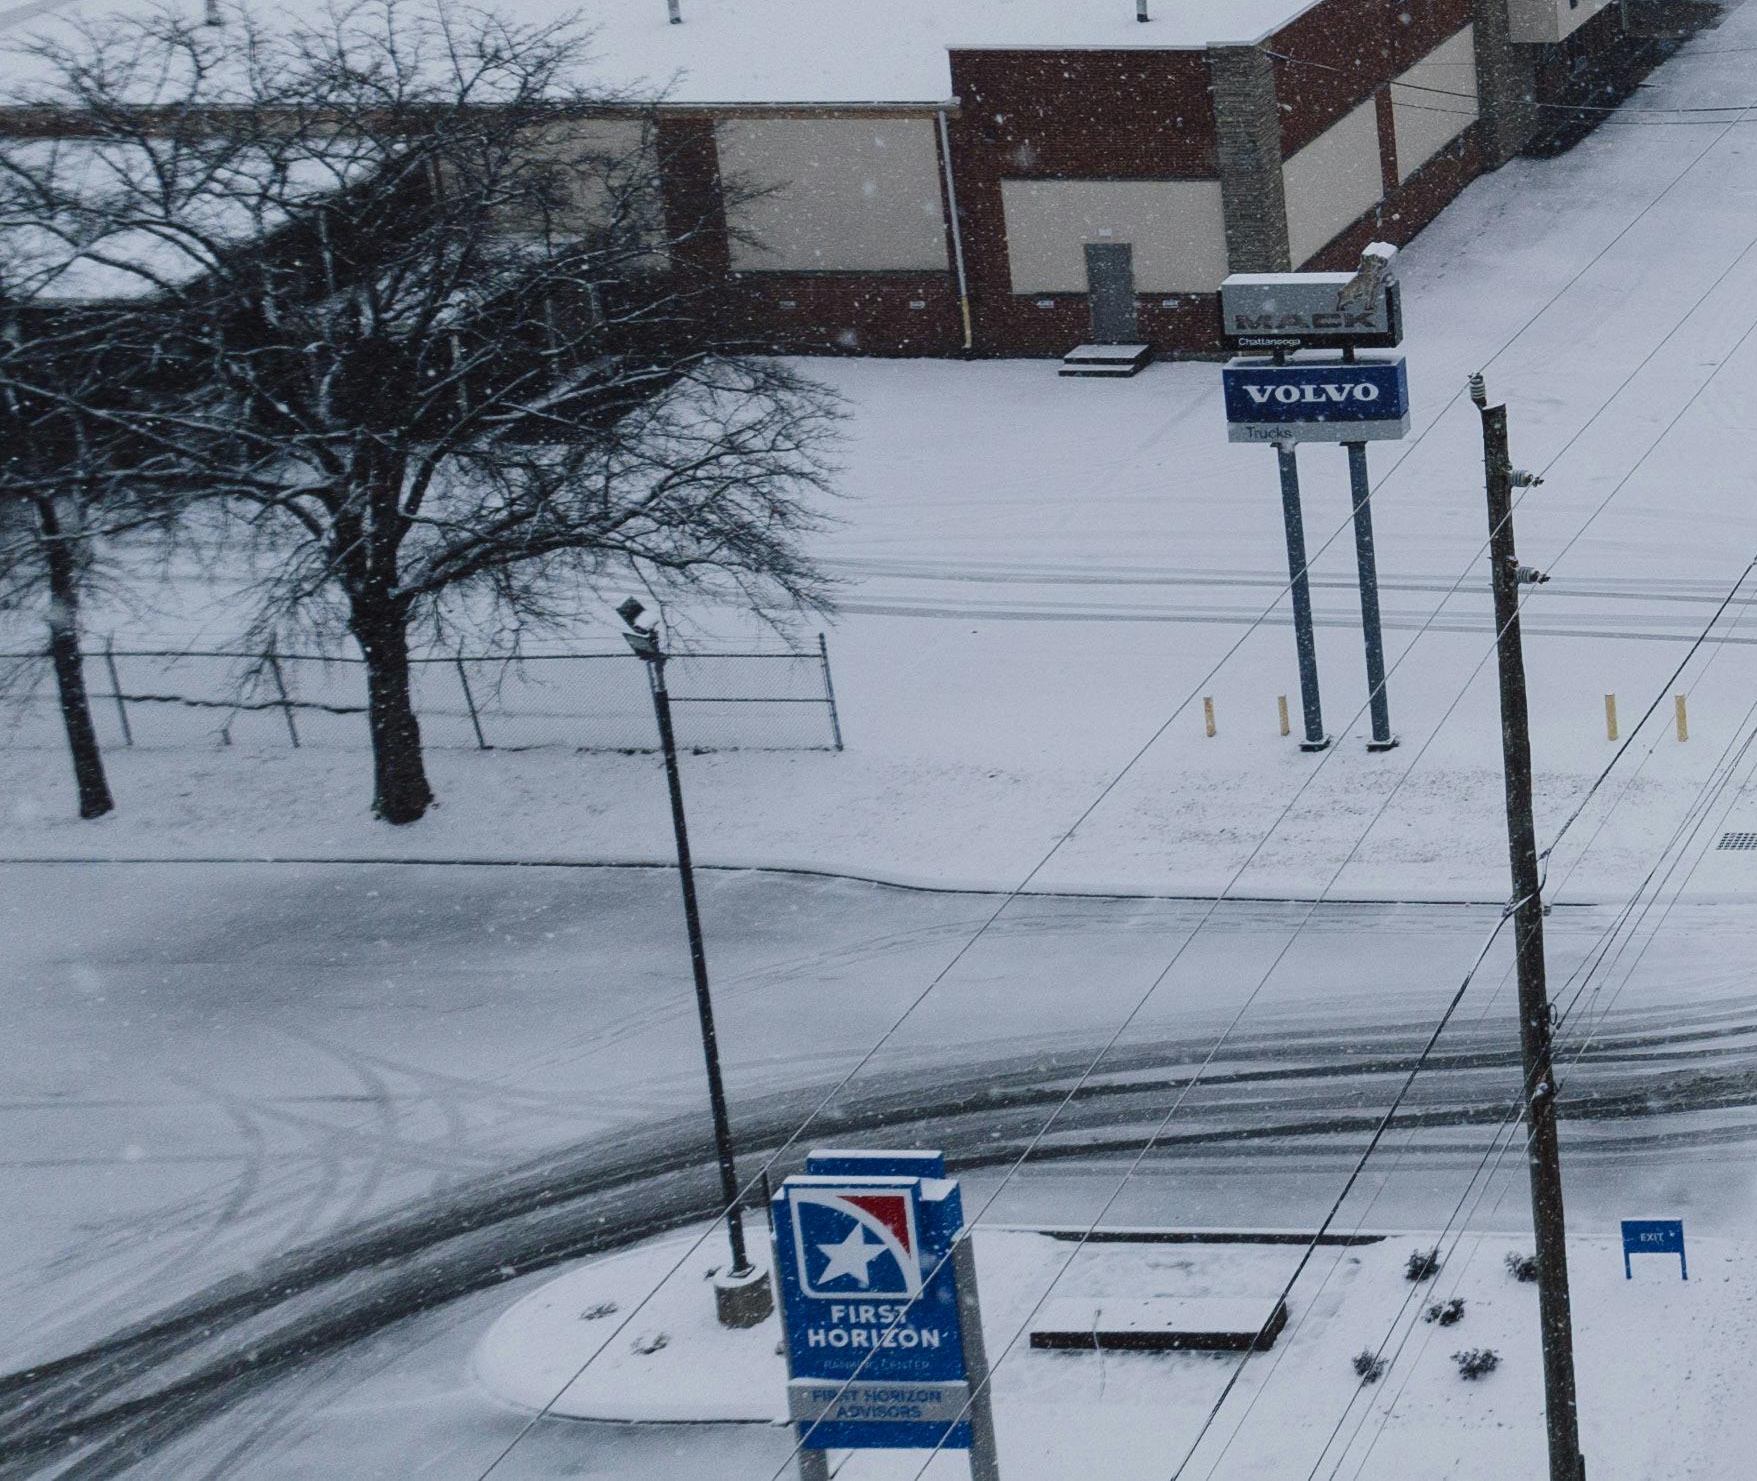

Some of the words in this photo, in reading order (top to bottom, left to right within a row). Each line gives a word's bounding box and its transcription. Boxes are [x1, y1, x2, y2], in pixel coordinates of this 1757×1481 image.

[1235, 313, 1377, 330] MACK
[1238, 337, 1301, 347] Chattanooga
[1242, 382, 1380, 404] VOLVO
[1246, 426, 1293, 440] Trucks
[1640, 1232, 1664, 1243] EXIT
[830, 1304, 908, 1325] FIRST
[807, 1328, 941, 1349] HORIZON
[811, 1390, 859, 1403] FIRST
[863, 1390, 943, 1403] HORIZON
[836, 1405, 922, 1419] ADVISORS
